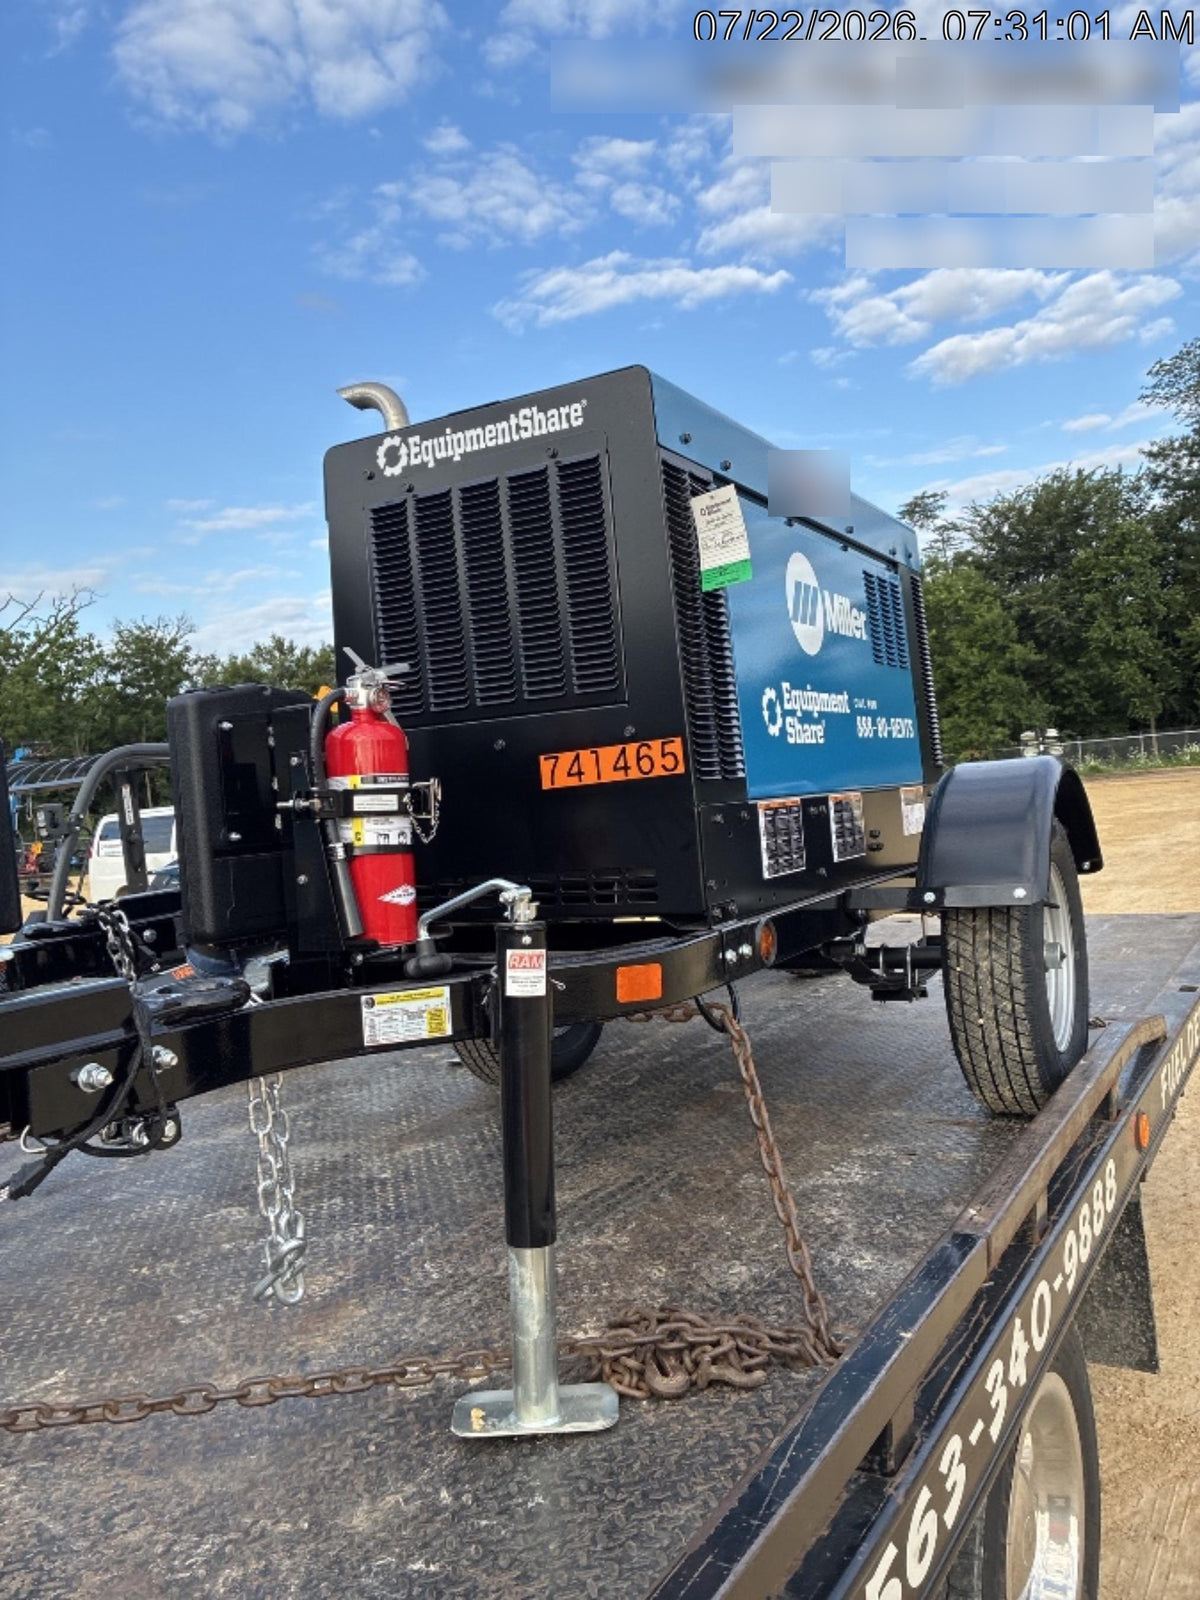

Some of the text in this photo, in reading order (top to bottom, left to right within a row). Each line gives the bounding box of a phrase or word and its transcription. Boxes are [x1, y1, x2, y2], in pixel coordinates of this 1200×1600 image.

[823, 589, 867, 641] Miller
[781, 681, 851, 718] Equipment
[785, 716, 825, 744] Share
[543, 739, 680, 786] 741465
[509, 954, 543, 969] RAM
[1161, 1037, 1187, 1110] FUEL
